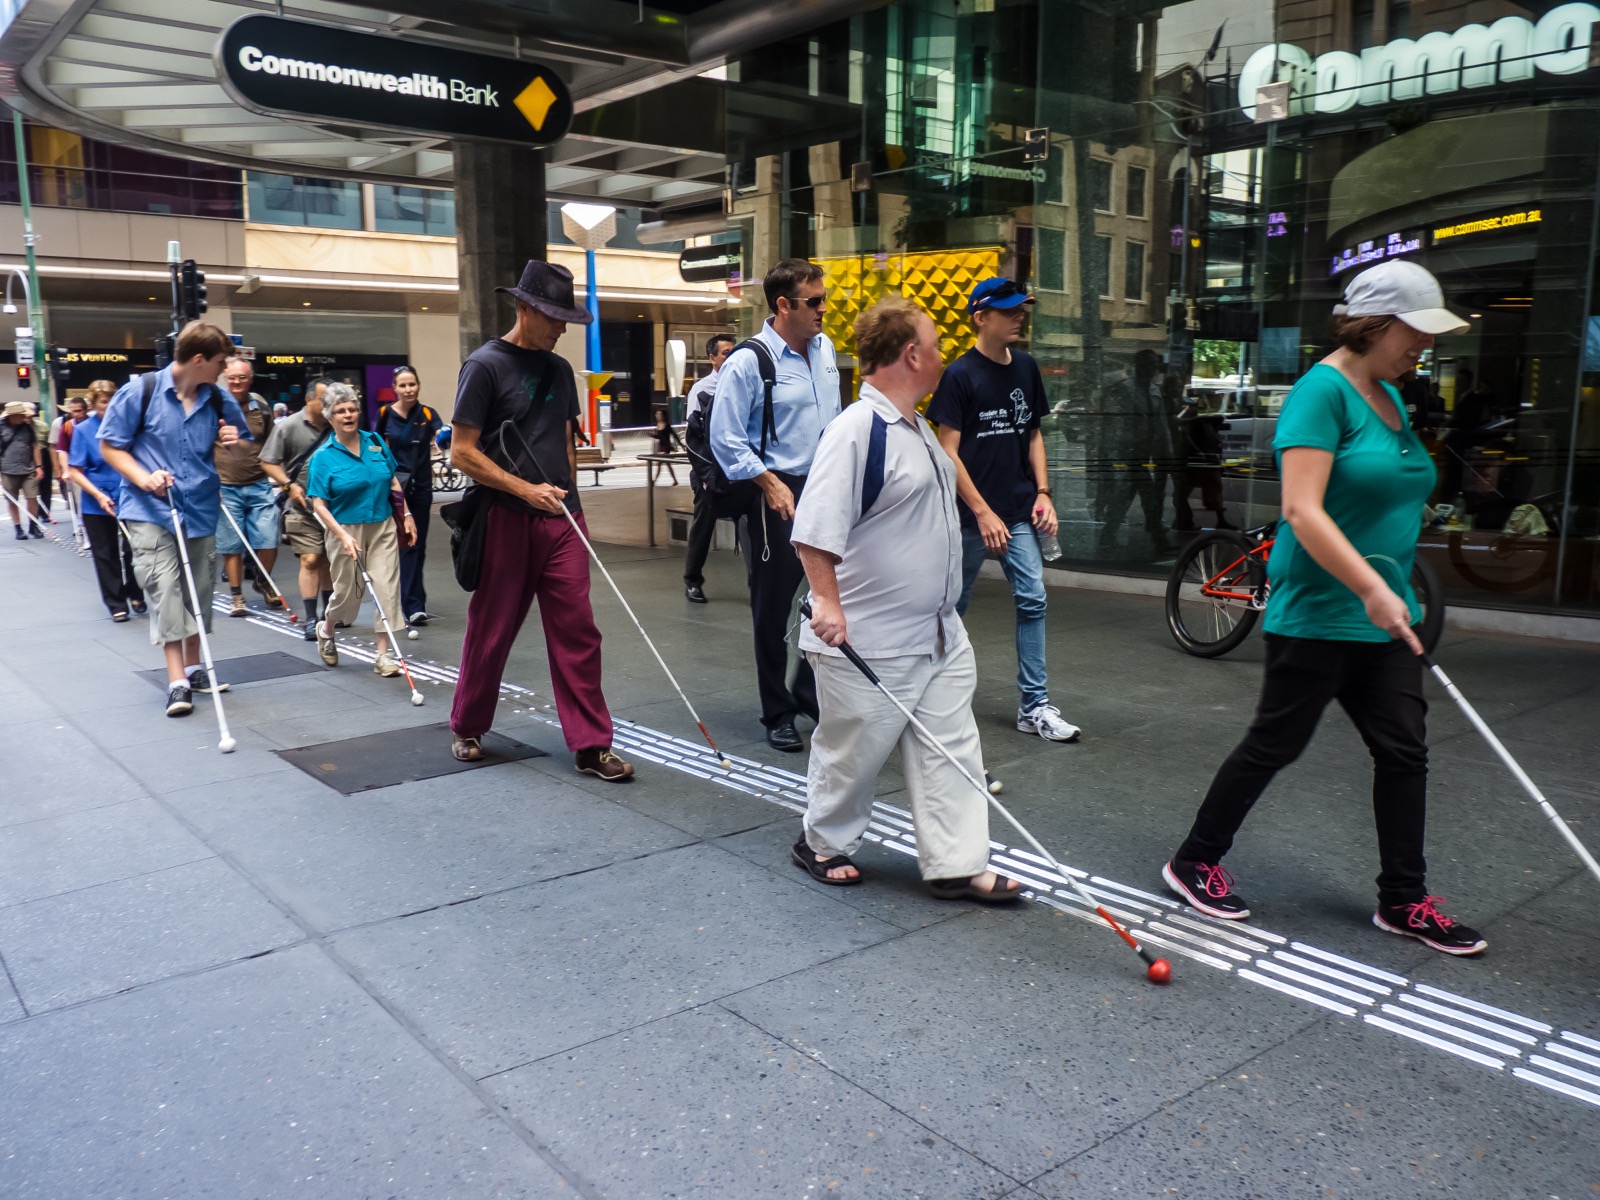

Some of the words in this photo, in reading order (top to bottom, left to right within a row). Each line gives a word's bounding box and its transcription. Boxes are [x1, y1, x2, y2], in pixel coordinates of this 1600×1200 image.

[238, 45, 448, 100] Commonwealth
[450, 79, 499, 107] Bank
[1433, 209, 1542, 239] www.commsec.com.au
[45, 353, 79, 362] LIS
[80, 353, 128, 362] VUITTON
[266, 356, 295, 364] LOUIS
